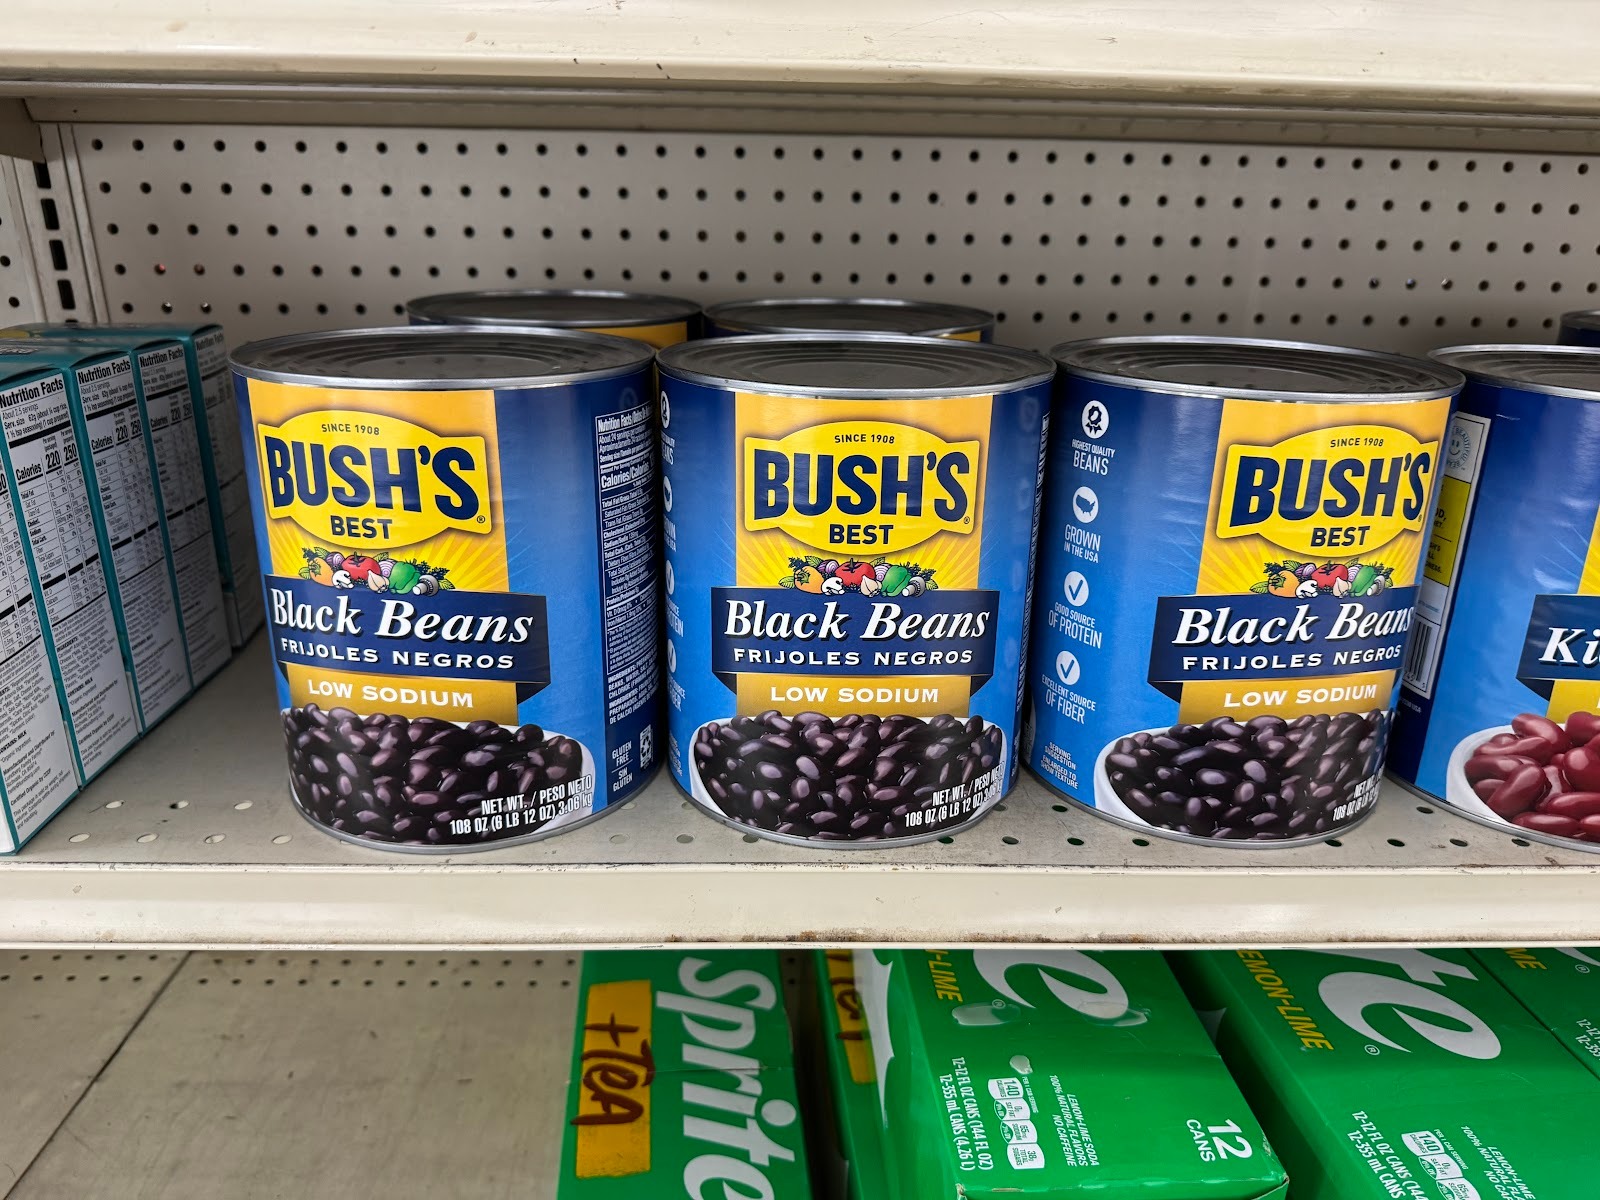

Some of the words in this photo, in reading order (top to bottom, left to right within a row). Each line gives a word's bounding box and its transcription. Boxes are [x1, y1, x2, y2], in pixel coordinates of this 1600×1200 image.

[140, 352, 168, 368] Nutrition
[168, 348, 184, 360] Facts
[78, 366, 112, 384] Nutrition
[112, 360, 130, 374] Facts
[0, 388, 40, 408] Nutrition
[40, 379, 64, 395] Facts
[2, 410, 14, 420] About
[22, 404, 38, 414] servings
[90, 436, 113, 450] Calories
[116, 424, 128, 441] 220
[322, 424, 351, 433] SINCE
[355, 424, 380, 435] 1908
[834, 434, 867, 444] SINCE
[870, 434, 895, 444] 1908
[1072, 439, 1092, 452] HIGHEST
[1092, 444, 1116, 458] QUALITY
[1330, 438, 1360, 448] SINCE
[1364, 437, 1384, 447] 1908
[16, 463, 42, 480] Calories
[46, 450, 60, 469] 220
[64, 443, 77, 461] 250
[1074, 450, 1108, 476] BEANS
[265, 436, 479, 520] BUSH'S
[754, 448, 970, 522] BUSH'S
[1230, 452, 1430, 528] BUSH'S
[330, 515, 393, 539] BEST
[829, 524, 894, 544] BEST
[1065, 524, 1100, 551] GROWN
[1310, 526, 1370, 547] BEST
[1064, 542, 1070, 552] IN
[1072, 544, 1083, 558] THE
[1084, 549, 1099, 563] USA
[269, 588, 362, 636] Black
[375, 598, 534, 643] Beans
[724, 599, 850, 640] Black
[860, 602, 990, 640] Beans
[1054, 602, 1069, 616] GOOD
[1070, 610, 1095, 628] SOURCE
[1171, 604, 1318, 646] Black
[1325, 602, 1414, 640] Beans
[1048, 609, 1058, 628] OF
[1060, 620, 1102, 649] PROTEIN
[281, 638, 379, 663] FRIJOLES
[392, 651, 514, 669] NEGROS
[734, 648, 860, 666] FRIJOLES
[874, 650, 972, 666] NEGROS
[1182, 653, 1322, 670] FRIJOLES
[1333, 645, 1402, 666] NEGROS
[1538, 627, 1600, 664] Ki
[307, 679, 354, 699] LOW
[363, 686, 474, 708] SODIUM
[770, 687, 828, 702] LOW
[838, 688, 938, 703] SODIUM
[1042, 674, 1068, 698] EXCELLENT
[1069, 692, 1096, 712] SOURCE
[1224, 691, 1287, 708] LOW
[1296, 684, 1376, 704] SODIUM
[1046, 689, 1056, 707] OF
[1057, 697, 1085, 724] FIBER
[612, 741, 632, 760] GLUTEN
[616, 752, 629, 766] FREE
[613, 773, 632, 792] GLUTEN
[618, 767, 628, 780] SIN
[1054, 767, 1078, 789] TEXTURE
[1068, 769, 1076, 780] TO
[481, 798, 504, 815] NET
[507, 794, 528, 810] WT.
[539, 784, 566, 805] PESO
[567, 774, 592, 796] NETO
[932, 789, 950, 806] NET
[952, 784, 966, 800] WT.
[974, 771, 990, 792] PESO
[450, 819, 472, 835] 108
[474, 817, 489, 833] OZ
[491, 815, 503, 832] (6
[506, 812, 520, 828] LB
[523, 809, 536, 825] 12
[539, 804, 556, 821] OZ)
[558, 795, 580, 816] 3.06
[582, 791, 593, 808] kg
[905, 811, 922, 828] 108
[925, 809, 936, 824] OZ
[938, 806, 948, 822] (6
[950, 802, 960, 817] LB
[962, 798, 971, 813] 12
[1333, 804, 1346, 821] 108
[925, 950, 962, 1002] -LIME
[1236, 950, 1334, 1050] EMON-LIME
[656, 957, 796, 1200] Sprite
[952, 1057, 968, 1076] 12-12
[940, 1074, 958, 1098] 12-355
[957, 1076, 971, 1086] FL
[960, 1086, 974, 1098] OZ
[1004, 1080, 1020, 1096] 140
[1050, 1074, 1063, 1094] 100%
[946, 1100, 960, 1112] mL
[964, 1098, 980, 1118] CANS
[1006, 1102, 1014, 1110] SAT
[1008, 1110, 1016, 1118] FAT
[1056, 1094, 1075, 1128] NATURAL
[950, 1114, 966, 1135] CANS
[968, 1120, 986, 1140] (144
[1052, 1114, 1064, 1126] NO
[1067, 1094, 1092, 1142] LEMON-LIME
[1084, 1142, 1100, 1166] SODA
[953, 1136, 973, 1160] (4.26
[974, 1142, 989, 1152] FL
[1056, 1127, 1078, 1167] CAFFEINE
[1068, 1128, 1088, 1166] FLAVORS
[1186, 1118, 1216, 1162] CANS
[1208, 1118, 1252, 1160] 12
[1352, 1110, 1376, 1132] 12-12
[1368, 1132, 1384, 1142] FL
[1376, 1142, 1394, 1155] OZ
[1386, 1156, 1412, 1178] CANS
[1419, 1134, 1440, 1152] 140
[1434, 1128, 1444, 1138] PER
[1444, 1142, 1454, 1150] CAN
[1451, 1151, 1468, 1170] SERVING
[960, 1162, 976, 1171] L)
[978, 1153, 994, 1170] OZ)
[1012, 1147, 1022, 1166] SUGARS
[1020, 1149, 1028, 1164] TOTAL
[1347, 1130, 1376, 1158] 12-355
[1368, 1158, 1387, 1174] mL
[1379, 1173, 1406, 1198] CANS
[1431, 1158, 1439, 1166] SAT
[1437, 1167, 1448, 1176] FAT
[1461, 1126, 1482, 1146] 100%
[1477, 1147, 1512, 1184] NATURAL
[1484, 1170, 1500, 1184] NO
[1488, 1146, 1536, 1200] LEMON-LIME
